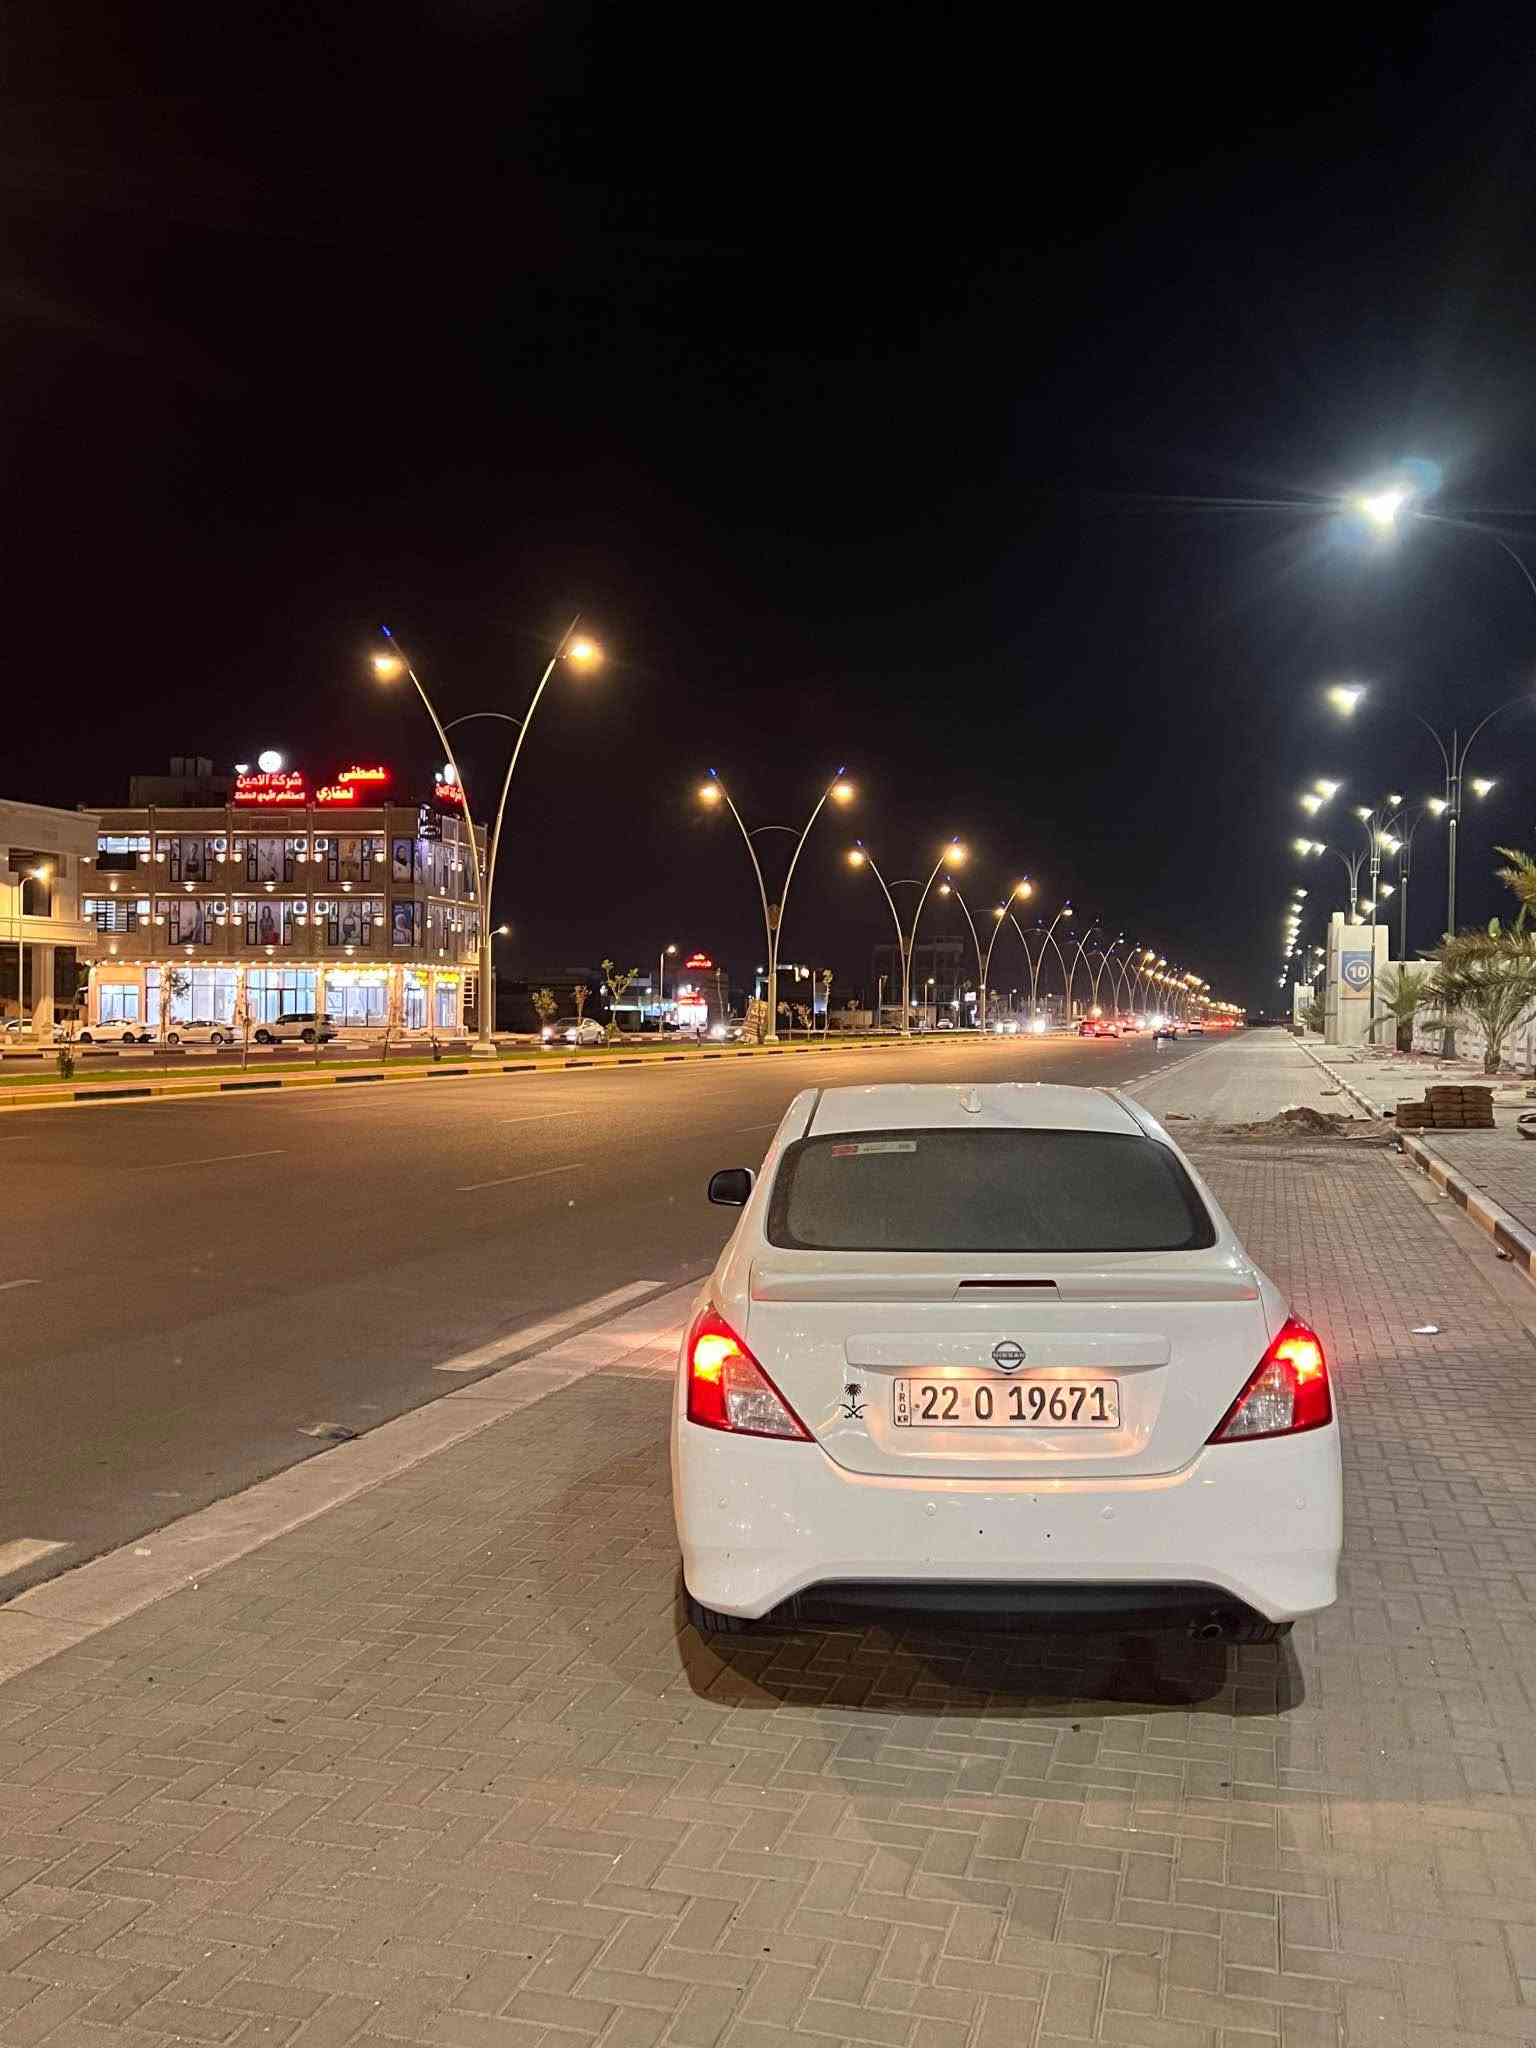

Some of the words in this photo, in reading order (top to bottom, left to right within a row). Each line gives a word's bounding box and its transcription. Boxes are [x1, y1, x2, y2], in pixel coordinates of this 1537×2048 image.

[272, 771, 303, 789] شركة
[921, 1385, 960, 1420] 22
[975, 1385, 994, 1420] 0
[1008, 1386, 1109, 1421] 19671
